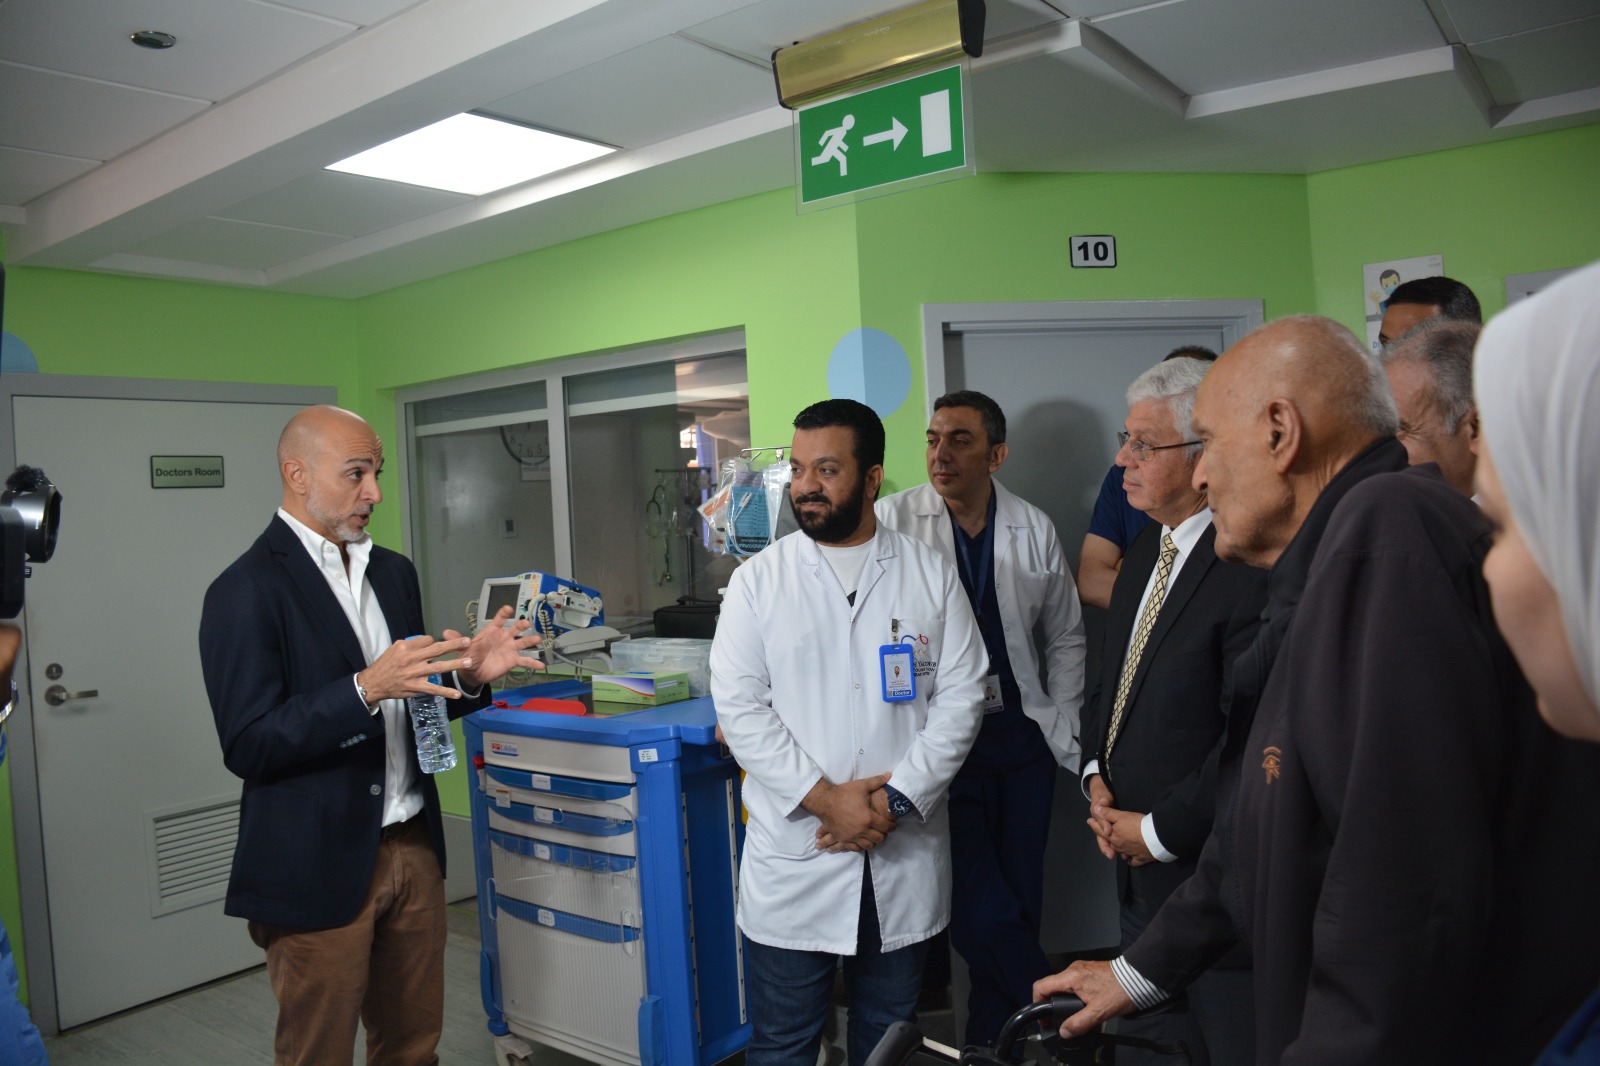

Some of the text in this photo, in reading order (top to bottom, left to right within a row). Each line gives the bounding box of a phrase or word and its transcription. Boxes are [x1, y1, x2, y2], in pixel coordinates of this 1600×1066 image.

[1077, 241, 1109, 261] 10
[155, 467, 221, 477] Doctors Room
